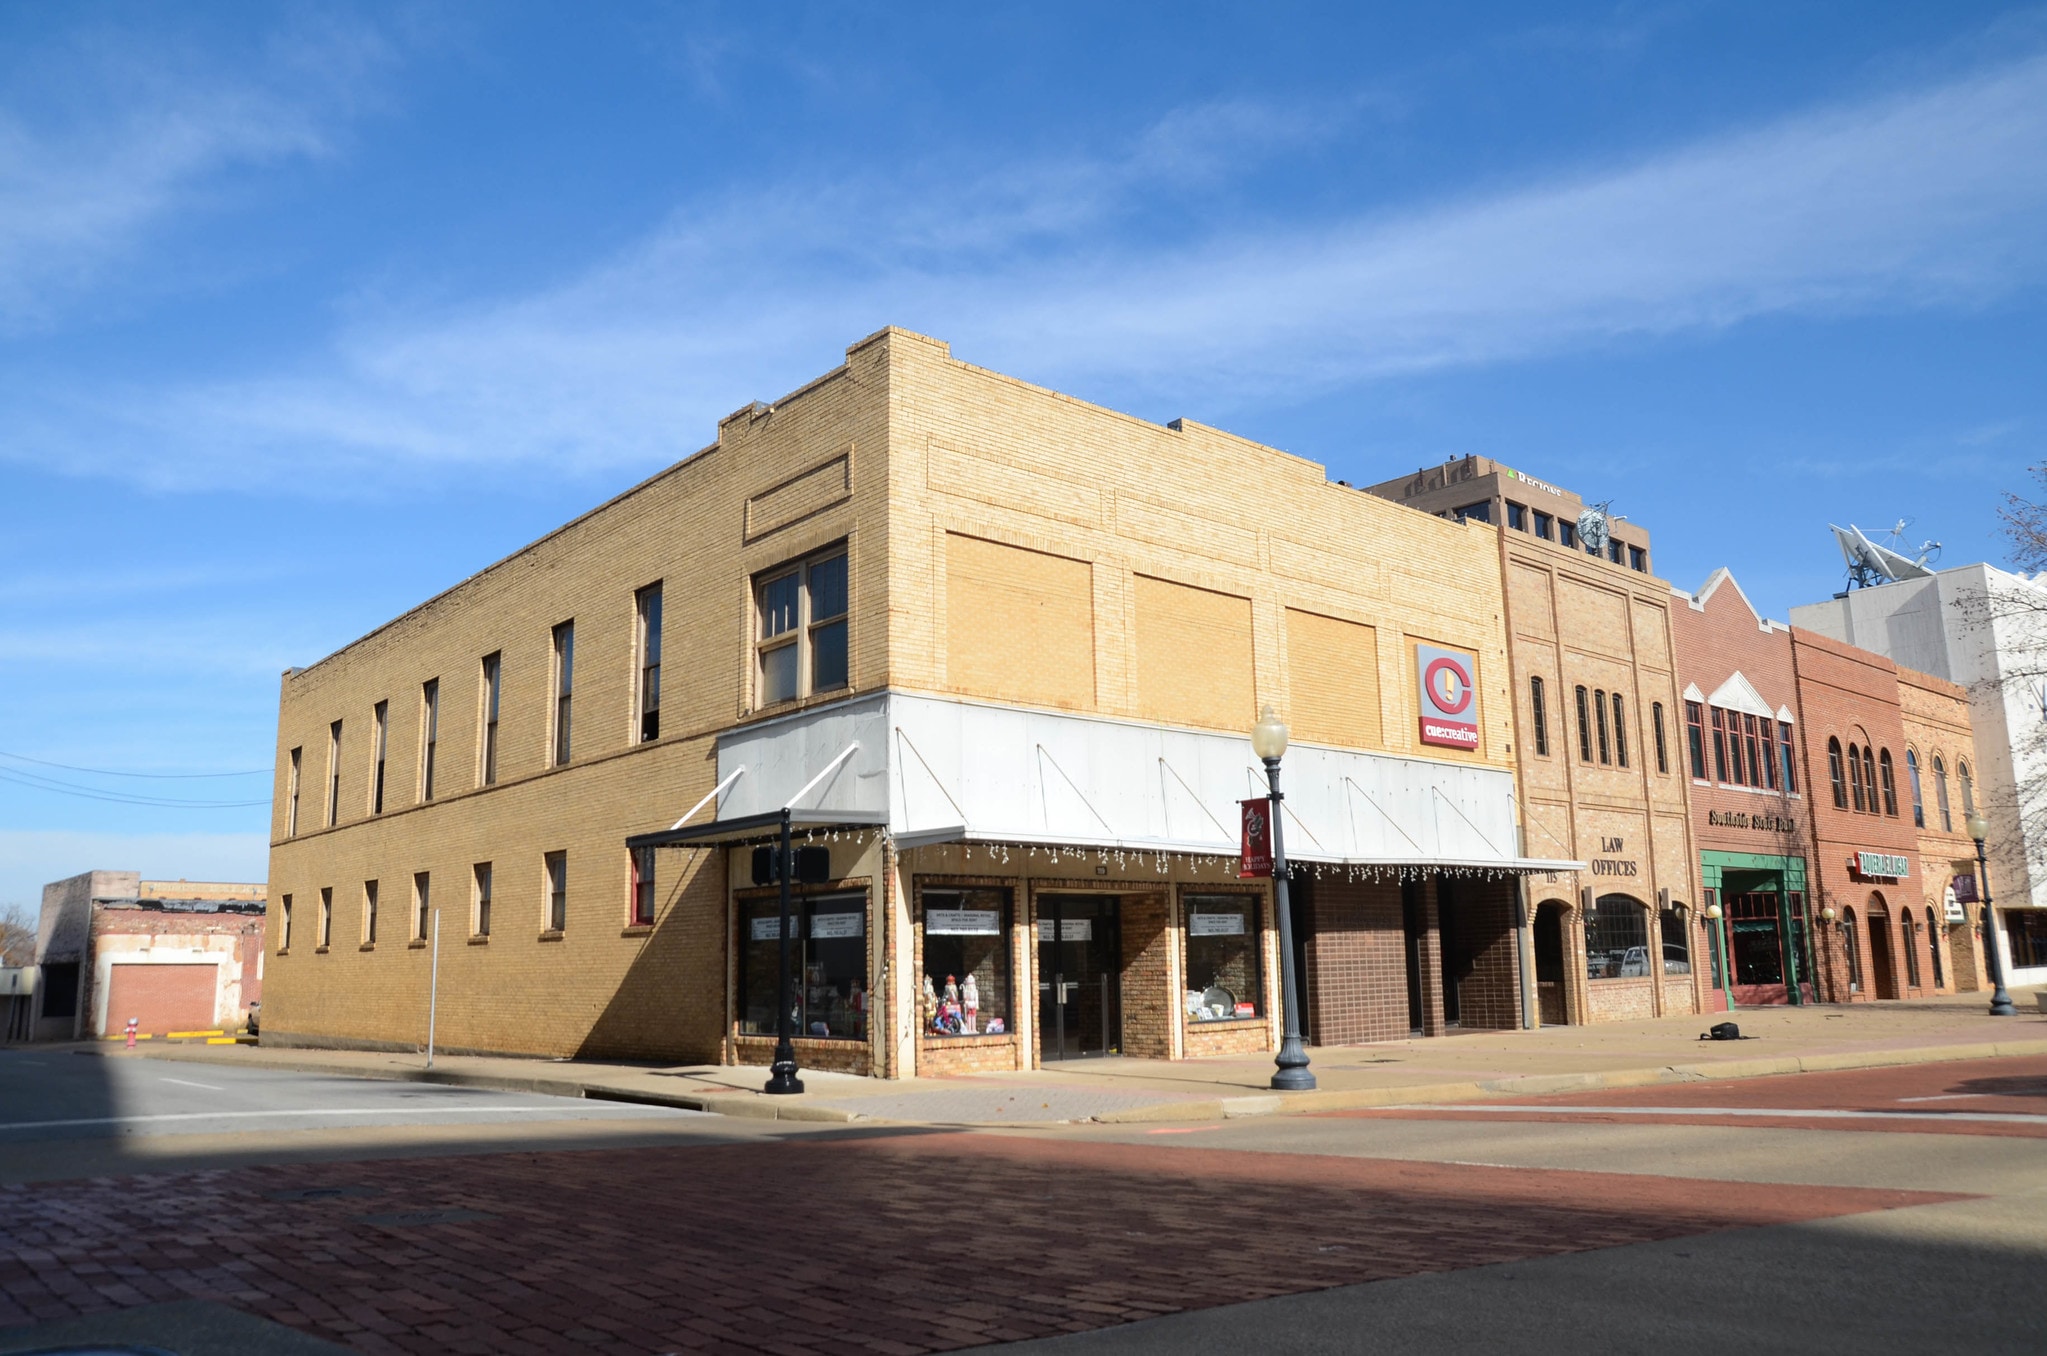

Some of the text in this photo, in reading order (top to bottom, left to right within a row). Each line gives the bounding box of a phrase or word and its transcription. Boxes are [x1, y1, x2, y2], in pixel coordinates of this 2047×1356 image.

[1517, 471, 1561, 496] REGIONS
[1425, 724, 1478, 742] cue:creative
[1601, 836, 1624, 853] LAW
[1592, 859, 1637, 877] OFFICES
[1858, 851, 1885, 877] TAQUERIA
